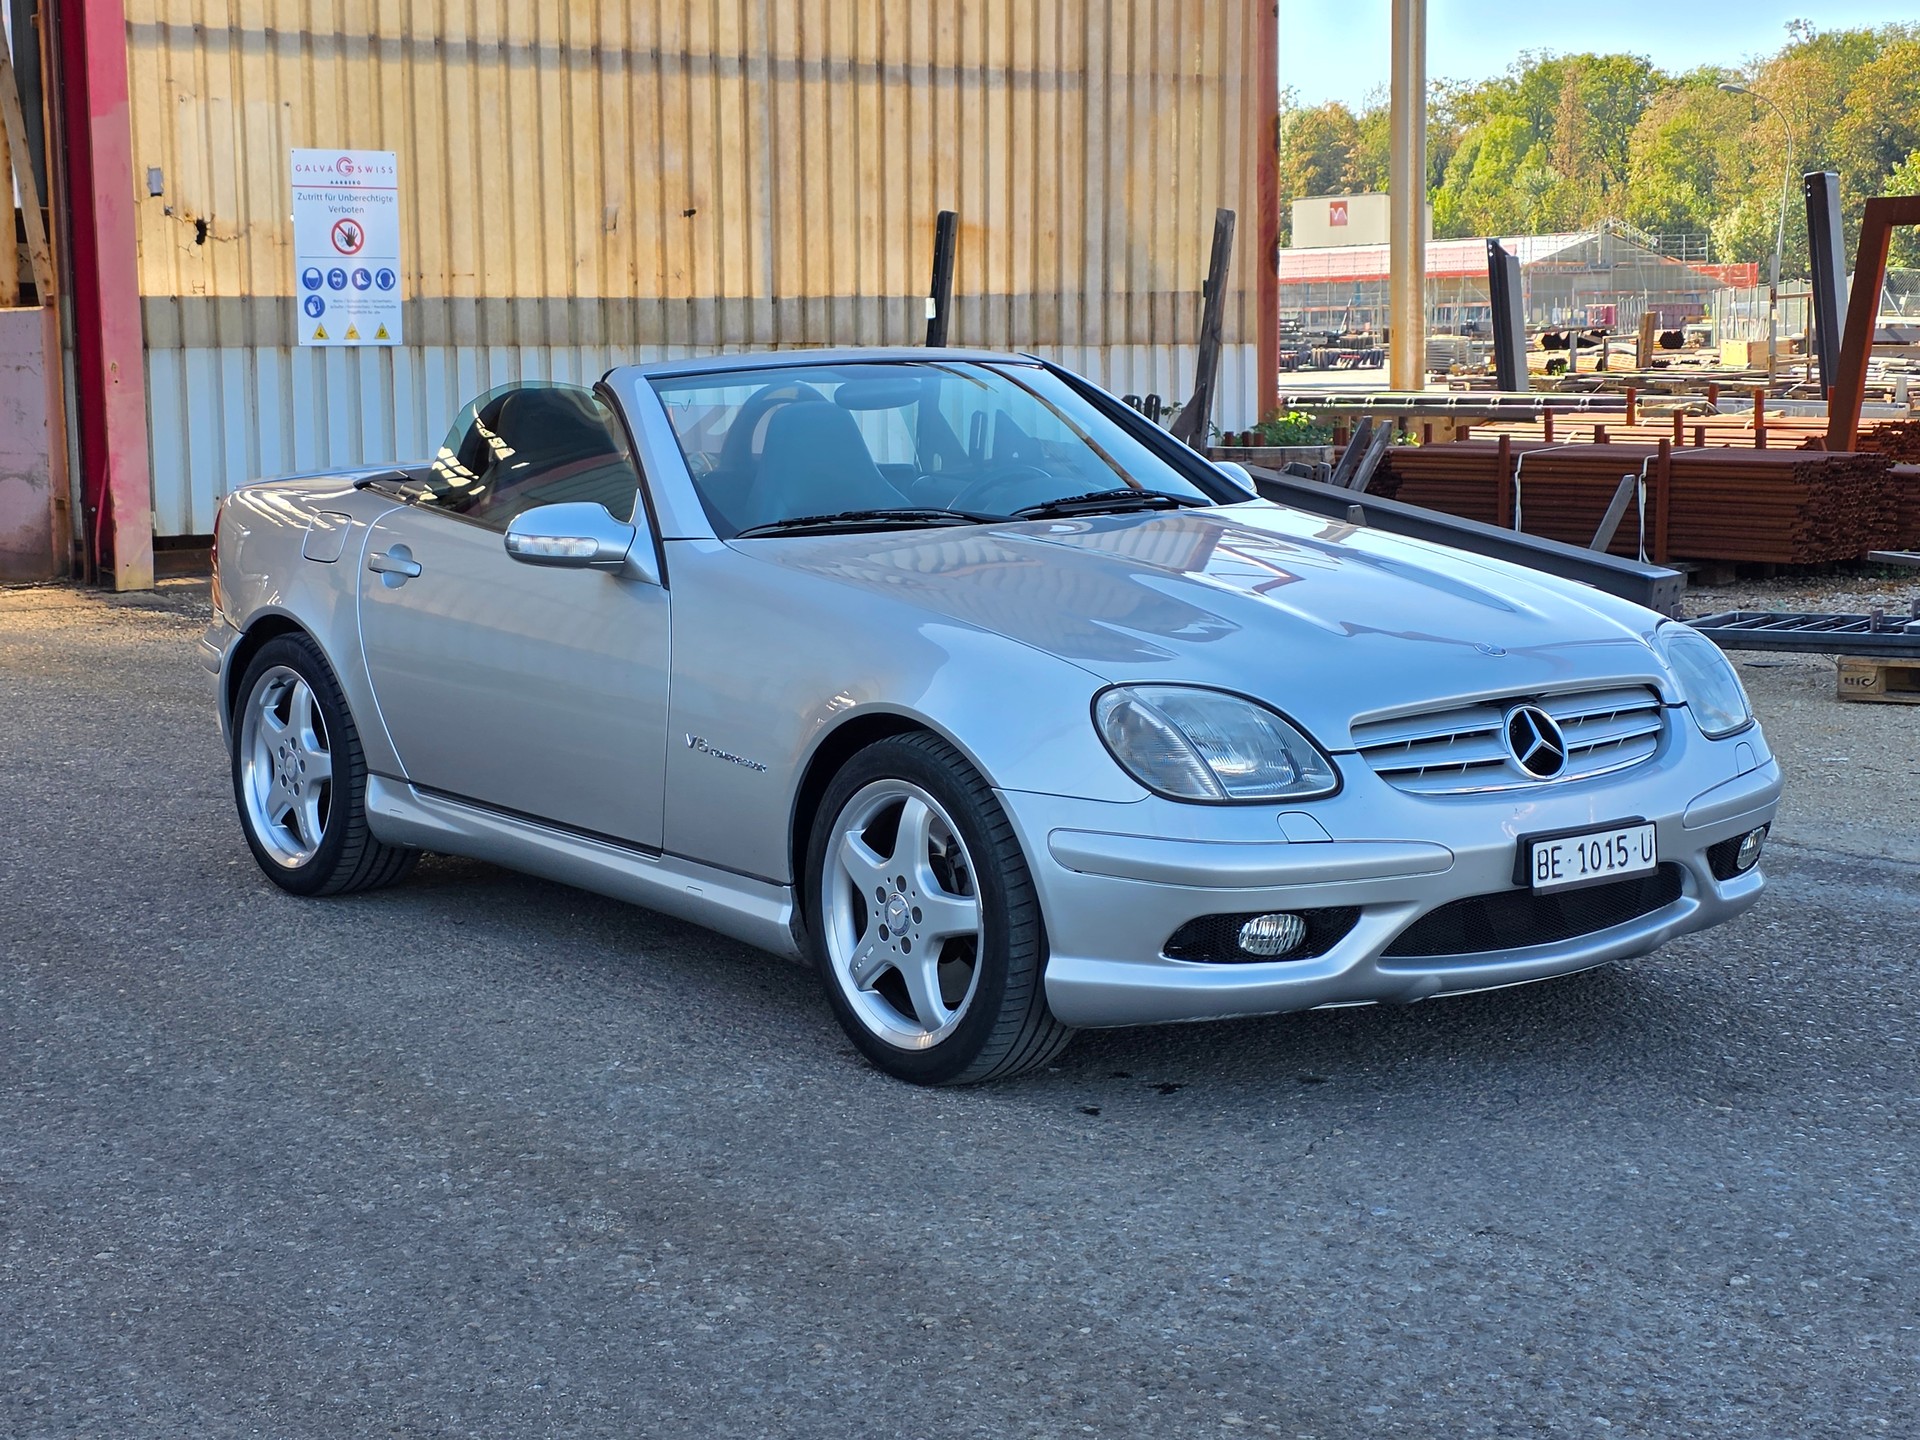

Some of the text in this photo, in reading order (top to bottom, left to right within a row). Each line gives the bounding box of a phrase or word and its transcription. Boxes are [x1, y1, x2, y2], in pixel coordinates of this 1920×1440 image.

[295, 164, 334, 173] GALVA
[357, 165, 394, 174] SWISS
[297, 192, 394, 204] Zutritt für Unberechtigte
[328, 205, 365, 214] Verboten
[685, 733, 709, 753] V6
